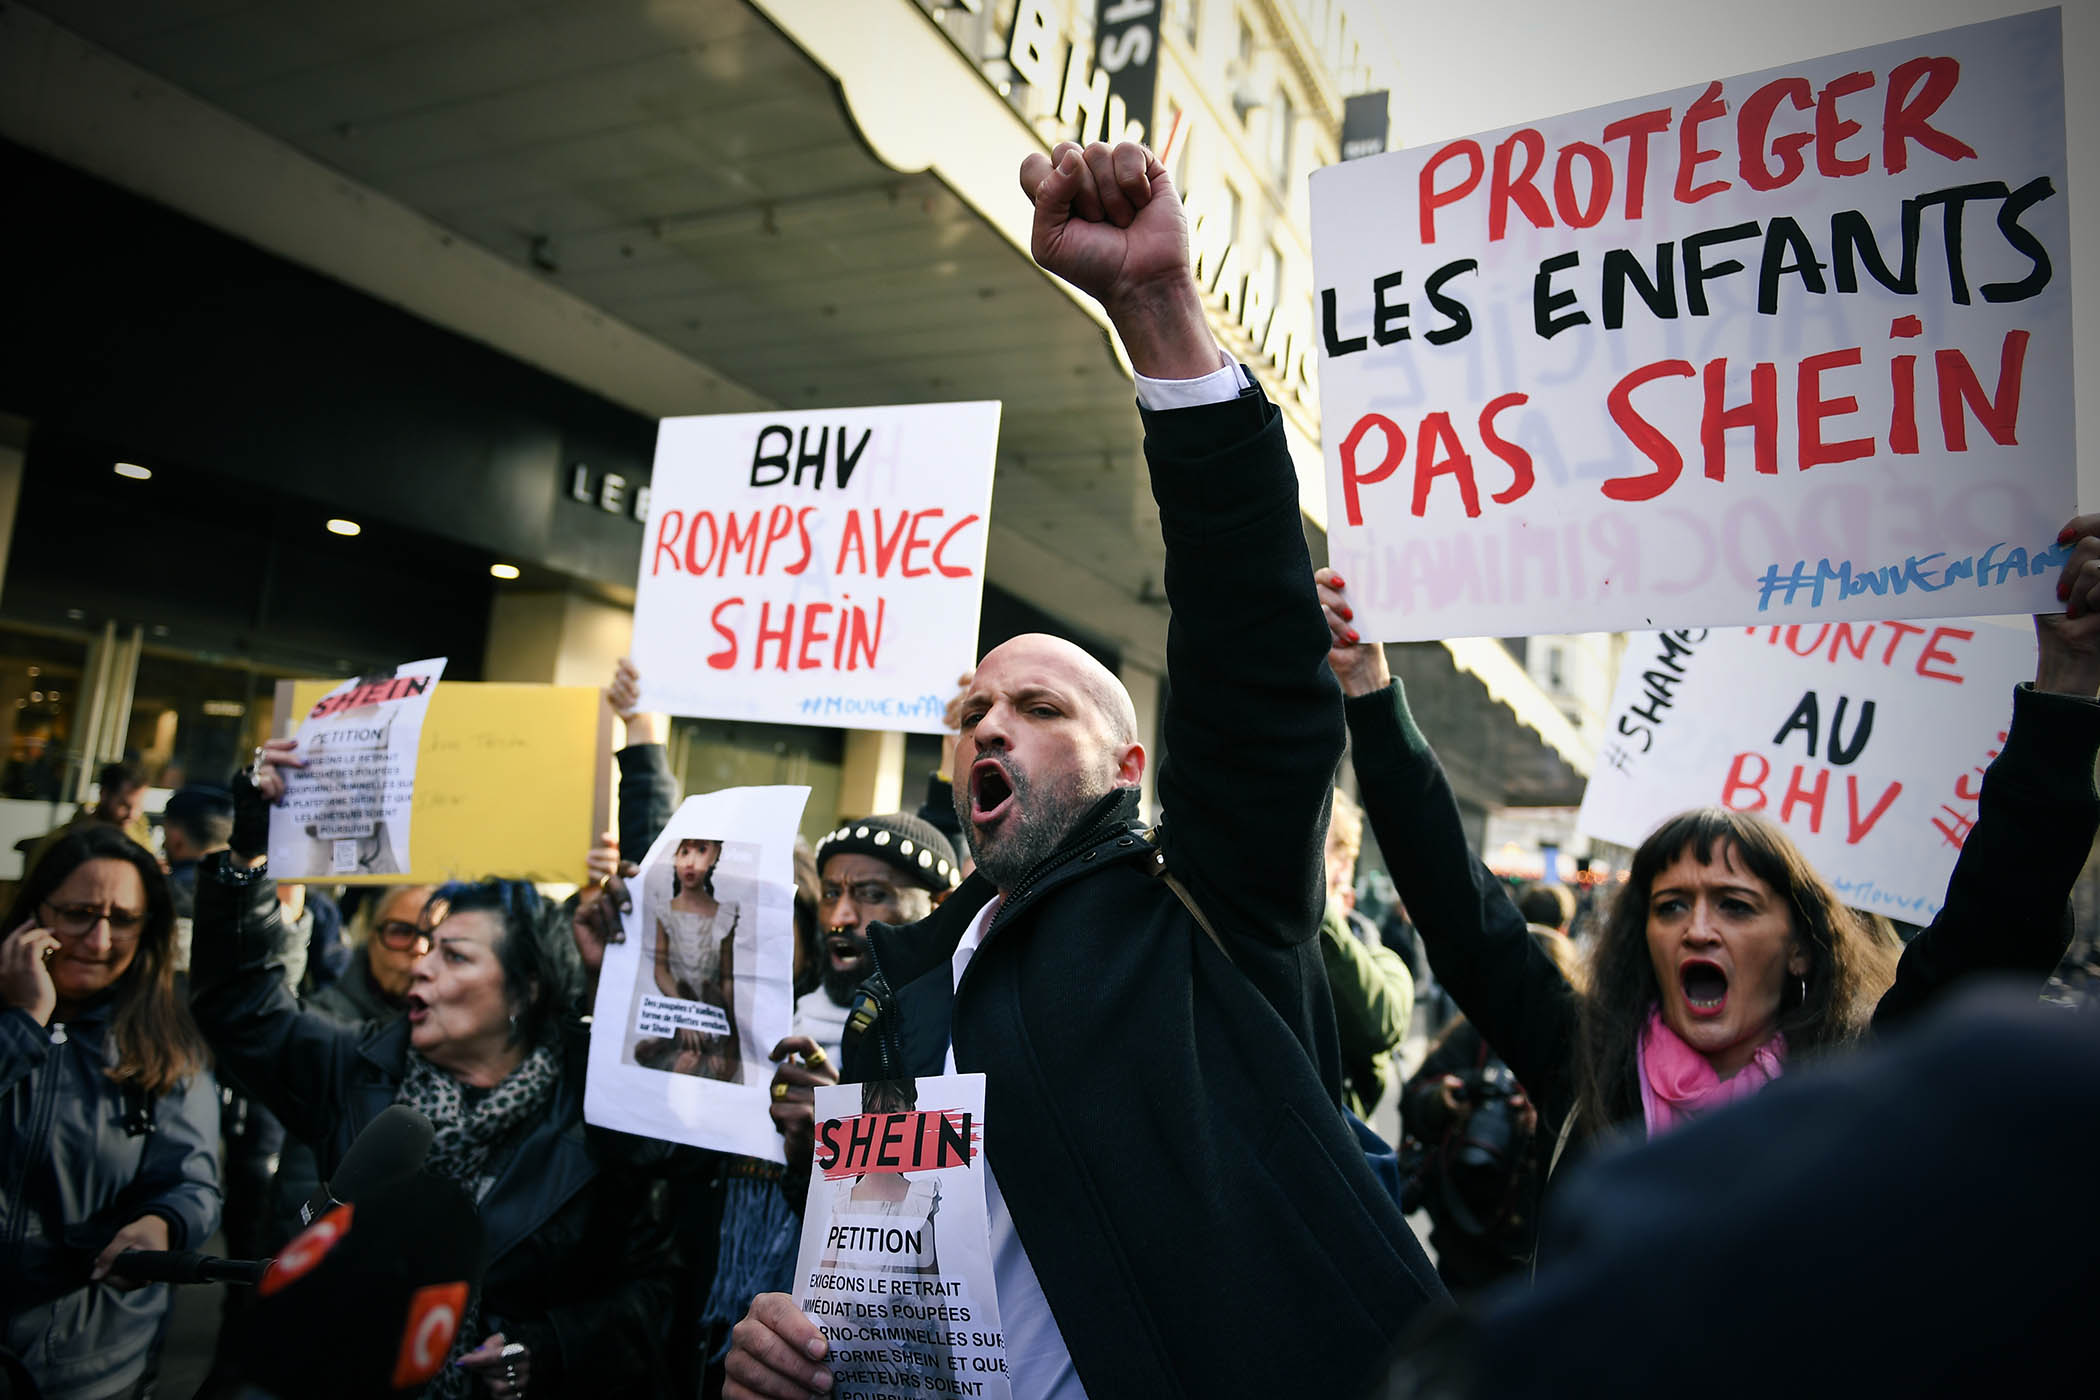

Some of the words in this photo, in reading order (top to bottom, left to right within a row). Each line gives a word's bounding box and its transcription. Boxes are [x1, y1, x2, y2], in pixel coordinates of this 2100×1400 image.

[1419, 56, 1977, 244] PROTÉGER
[1321, 258, 1479, 358] LES
[1533, 176, 2056, 340] ENFANTS
[750, 424, 872, 491] BHV
[1339, 392, 1535, 526] PAS
[653, 504, 819, 578] ROMPS
[836, 507, 980, 579] AVEC
[310, 675, 432, 719] SHEIN
[1772, 690, 1876, 765] AU
[1721, 751, 1903, 845] BHV
[818, 1112, 972, 1170] SHEIN
[826, 1226, 923, 1255] PETITION
[802, 1296, 852, 1317] IMMÉDIAT
[856, 1303, 888, 1318] DES
[892, 1303, 971, 1322] POUPÉES
[809, 1273, 865, 1293] EXIGEONS
[868, 1278, 887, 1294] LE
[891, 1280, 961, 1297] RETRAIT
[820, 1325, 968, 1347] RNO-CRIMINELLES
[892, 1349, 939, 1369] SHEIN
[947, 1356, 967, 1371] ET
[834, 1370, 921, 1389] CHETEURS
[925, 1376, 983, 1397] SOIENT
